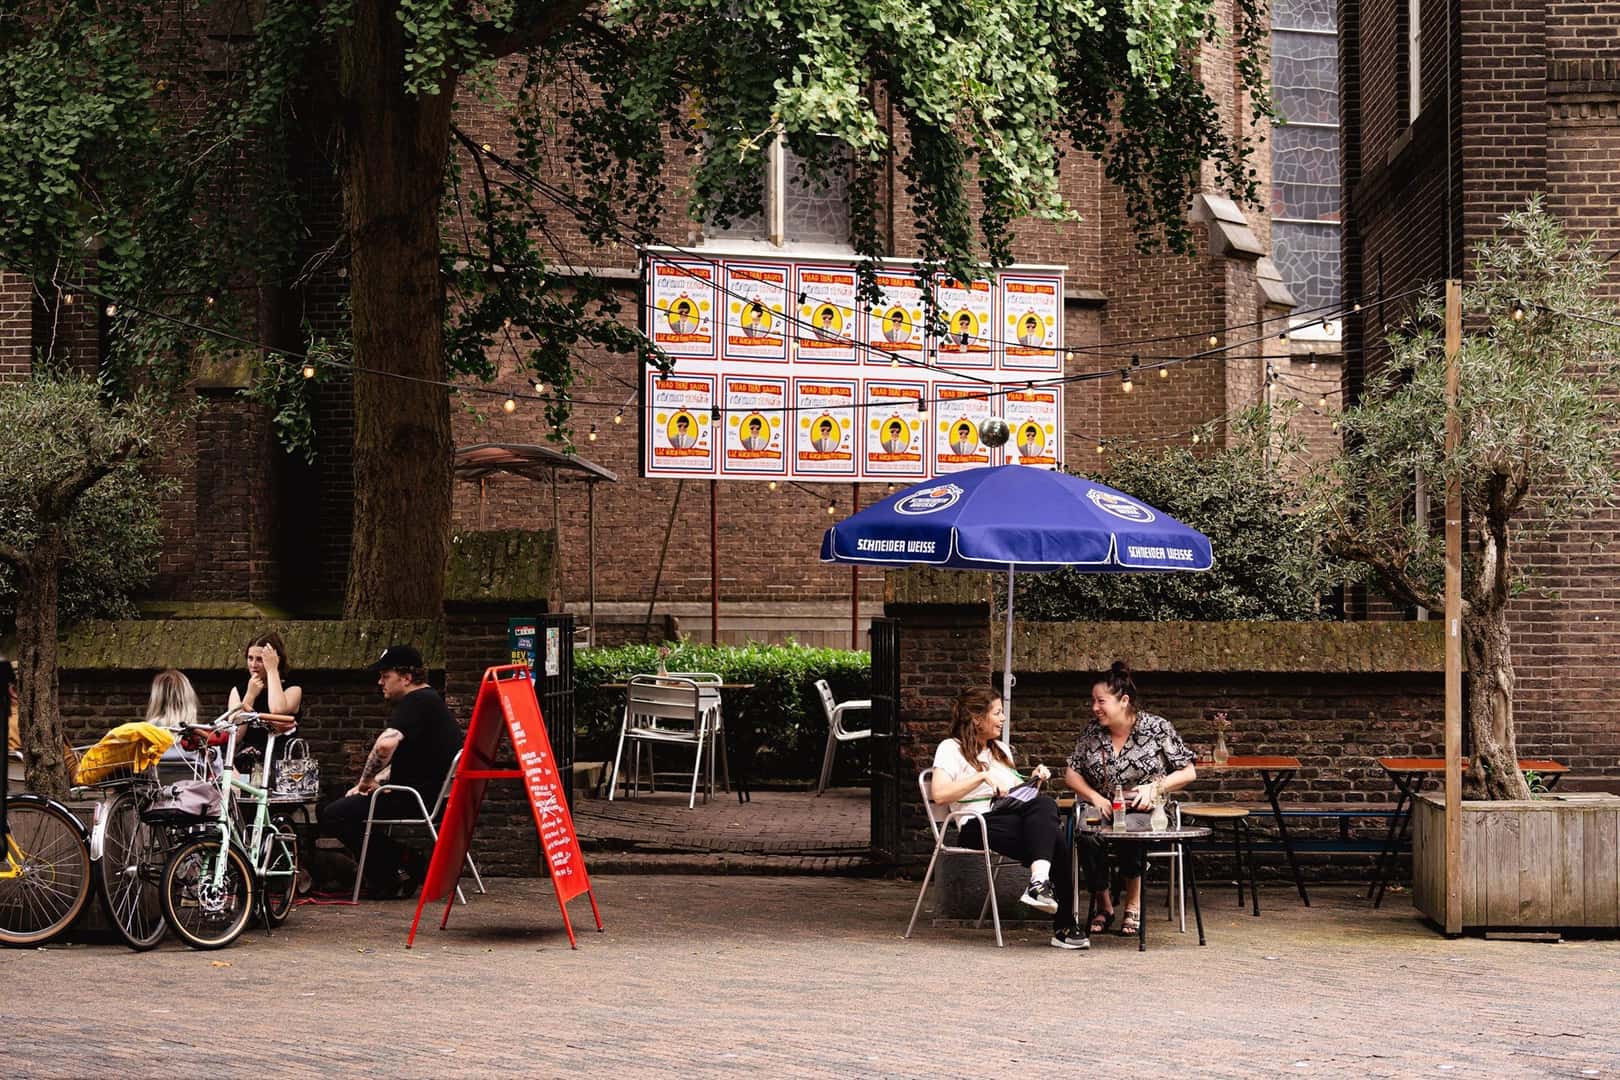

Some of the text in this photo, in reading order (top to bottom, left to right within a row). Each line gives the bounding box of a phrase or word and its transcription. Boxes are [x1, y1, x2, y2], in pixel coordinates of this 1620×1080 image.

[857, 538, 936, 554] SCHNEIDER WEISSE
[1167, 548, 1194, 561] WEISSE
